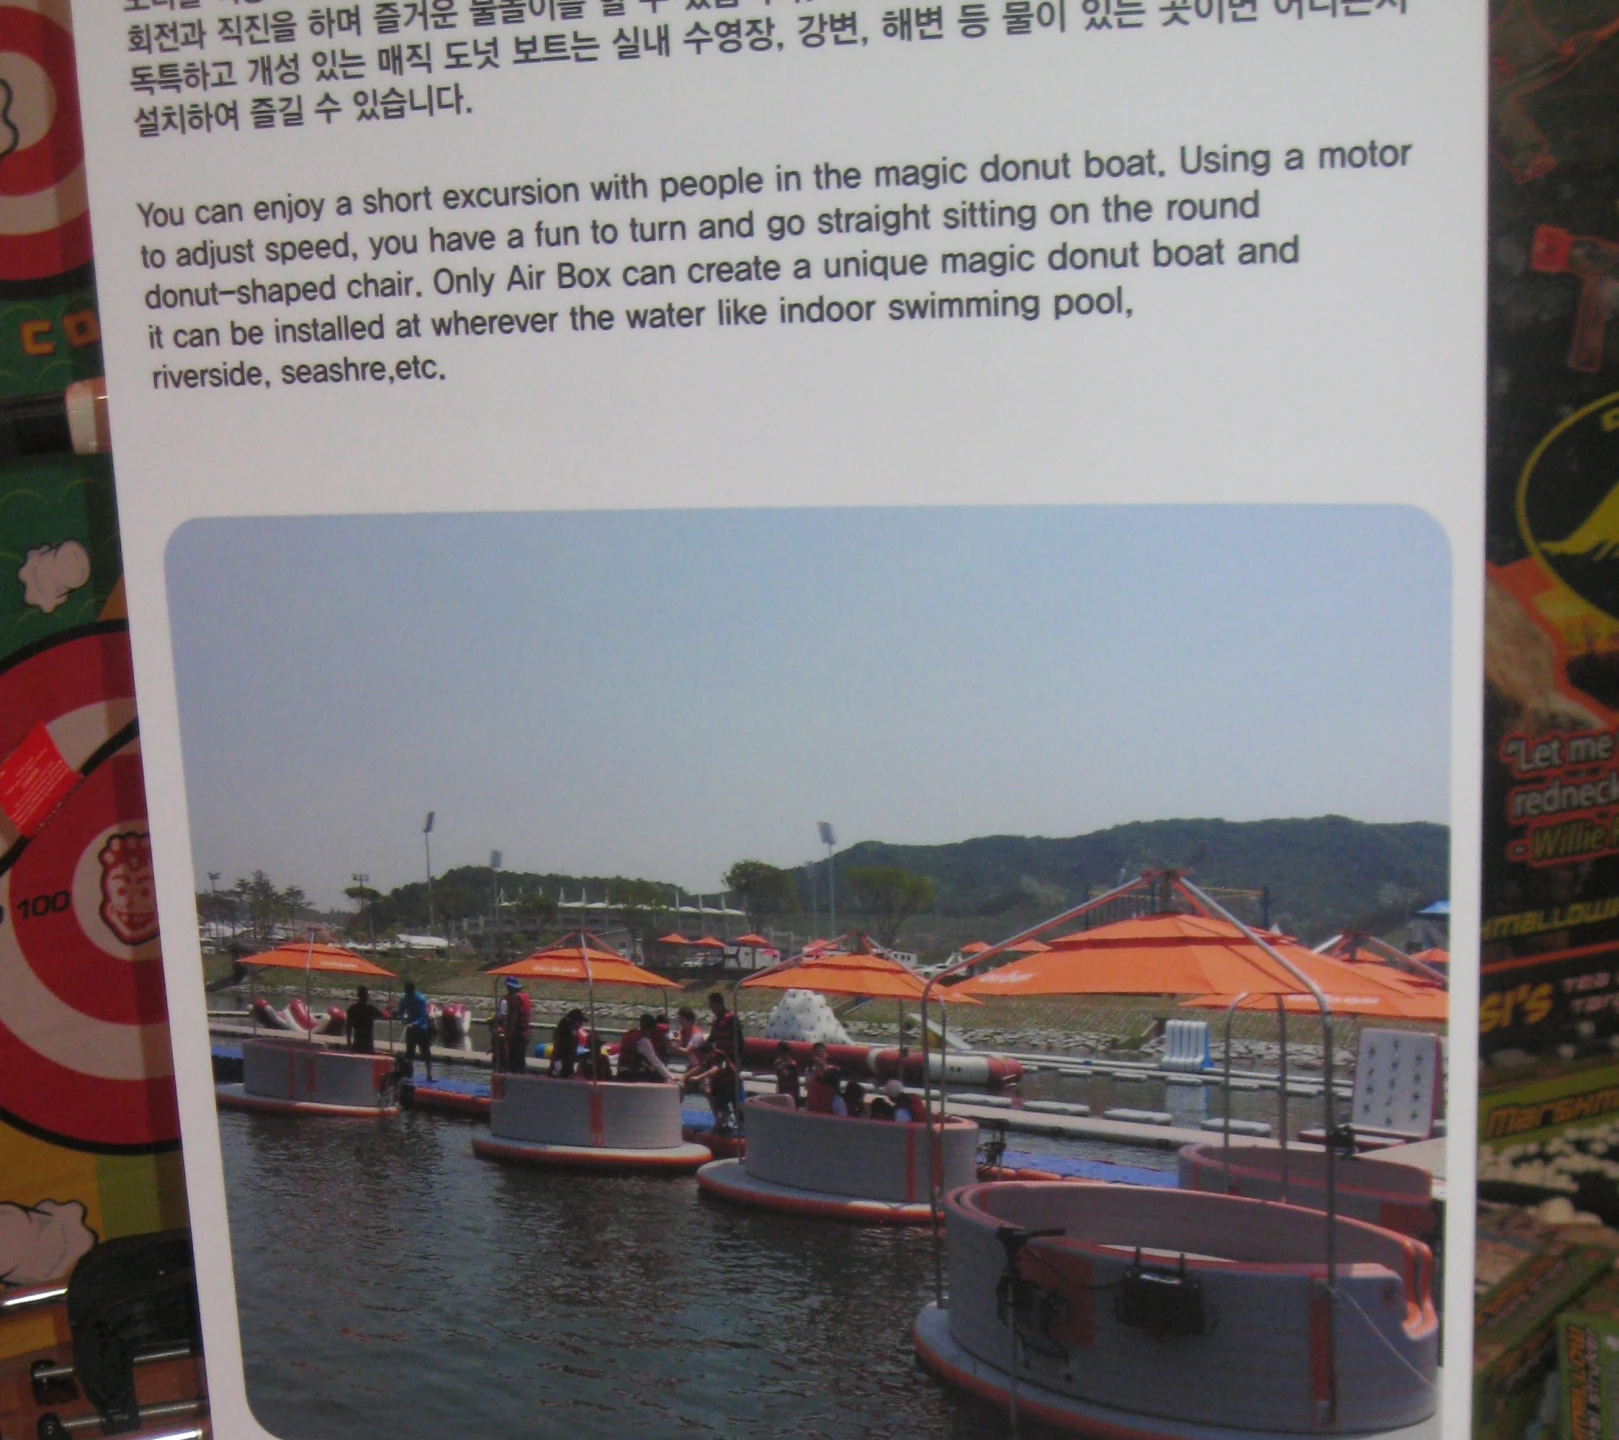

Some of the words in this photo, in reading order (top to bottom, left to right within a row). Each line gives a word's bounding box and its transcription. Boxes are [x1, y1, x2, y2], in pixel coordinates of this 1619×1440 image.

[128, 18, 207, 55] 회전과
[217, 10, 297, 46] 직진을
[308, 4, 361, 39] 하며
[373, 0, 458, 34] 즐거운
[130, 60, 237, 95] 독특하고
[248, 52, 300, 86] 개성
[312, 49, 366, 82] 있는
[378, 42, 432, 76] 매직
[444, 36, 500, 70] 도넛
[513, 30, 600, 64] 보트는
[612, 24, 670, 60] 실내
[683, 17, 784, 55] 수영장,
[798, 11, 868, 48] 강변,
[882, 5, 944, 41] 해변
[957, 4, 990, 38] 등
[1002, 0, 1065, 35] 물이
[1081, 0, 1146, 31] 있는
[134, 100, 239, 138] 설치하여
[250, 95, 304, 129] 즐길
[314, 92, 342, 124] 수
[353, 82, 472, 121] 있습니다.
[136, 202, 184, 228] You
[195, 203, 243, 225] can
[253, 193, 325, 224] enjoy
[336, 196, 352, 216] a
[363, 186, 432, 215] short
[443, 178, 579, 210] excursion
[590, 172, 648, 201] with
[660, 167, 764, 203] people
[776, 164, 801, 192] in
[813, 162, 862, 190] the
[875, 156, 967, 190] magic
[980, 152, 1071, 183] donut
[1084, 149, 1165, 178] boat.
[1180, 144, 1271, 177] Using
[1284, 148, 1304, 171] a
[1319, 140, 1412, 169] motor
[141, 245, 166, 269] to
[176, 239, 255, 269] adjust
[265, 231, 358, 265] speed,
[368, 234, 417, 260] you
[429, 227, 496, 252] have
[507, 228, 524, 249] a
[535, 220, 579, 247] fun
[590, 219, 618, 244] to
[629, 217, 686, 242] turn
[698, 210, 754, 240] and
[767, 214, 805, 241] go
[818, 203, 931, 236] straight
[943, 199, 1036, 231] sitting
[1050, 203, 1089, 225] on
[1102, 194, 1153, 223] the
[1167, 189, 1259, 221] round
[347, 272, 422, 299] chair.
[433, 267, 495, 297] Only
[507, 264, 545, 291] Air
[557, 262, 612, 289] Box
[622, 264, 675, 287] can
[687, 255, 781, 284] create
[793, 258, 811, 280] a
[824, 249, 928, 281] unique
[941, 244, 1035, 277] magic
[1048, 241, 1139, 271] donut
[1153, 238, 1225, 268] boat
[1238, 234, 1299, 265] and
[148, 325, 164, 349] it
[173, 327, 220, 348] can
[230, 320, 264, 346] be
[274, 313, 384, 343] installed
[396, 313, 421, 339] at
[431, 310, 559, 336] wherever
[569, 305, 615, 331] the
[625, 302, 706, 329] water
[718, 298, 767, 325] like
[780, 295, 876, 323] indoor
[888, 289, 1040, 321] swimming
[1054, 285, 1133, 320] pool,
[153, 360, 271, 389] riverside,
[1567, 734, 1612, 761] me
[16, 889, 70, 920] 100
